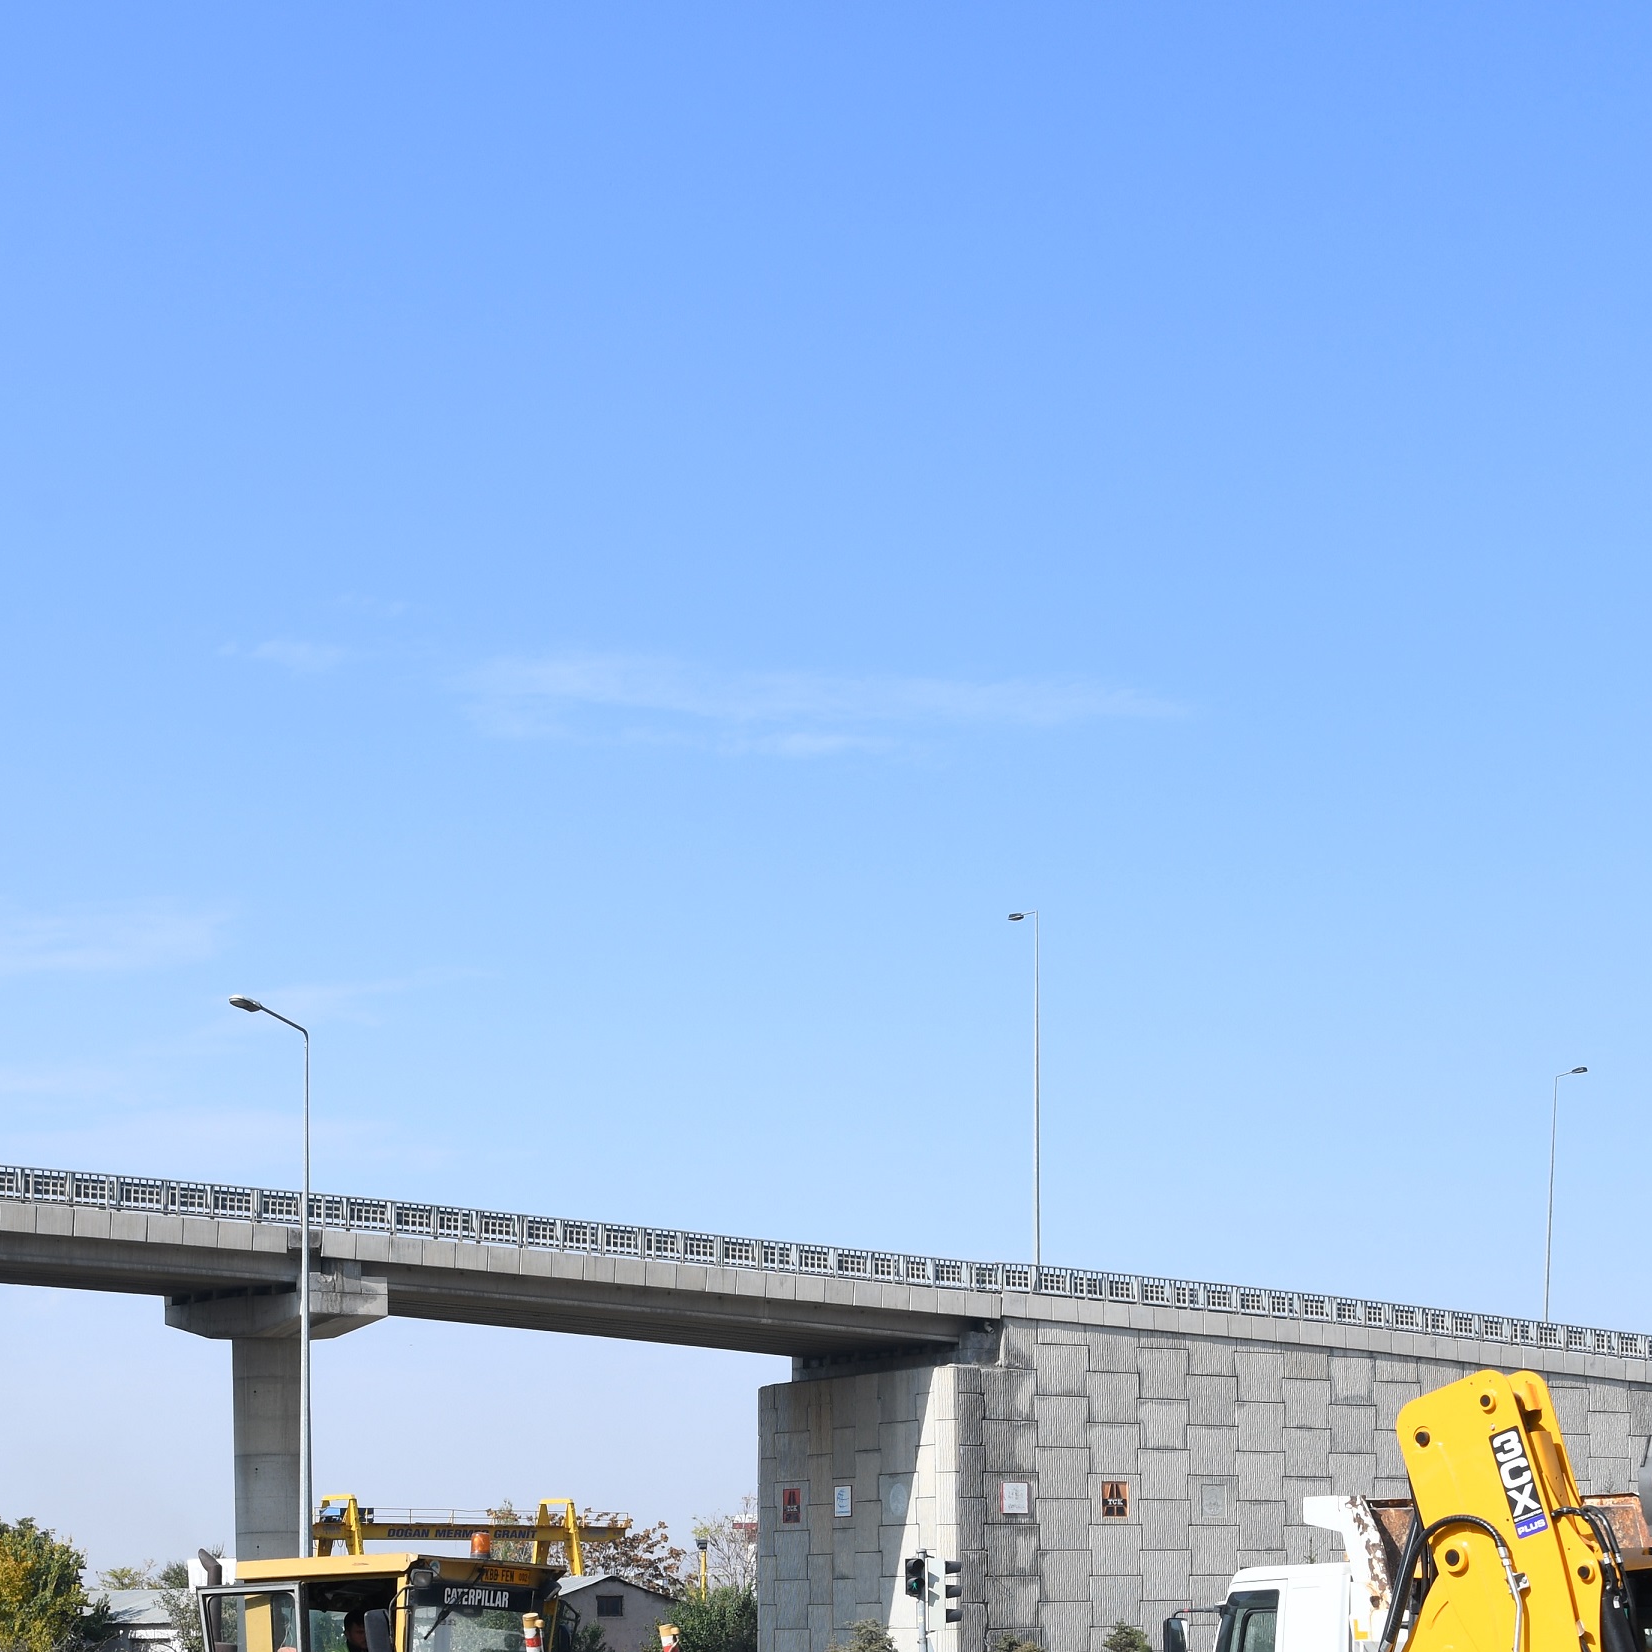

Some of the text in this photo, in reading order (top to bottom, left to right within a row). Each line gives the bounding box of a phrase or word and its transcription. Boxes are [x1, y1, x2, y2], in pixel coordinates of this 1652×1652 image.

[1492, 1430, 1540, 1518] 3CX
[387, 1526, 431, 1538] DOĞAN
[494, 1528, 537, 1539] GRANİT
[1517, 1519, 1546, 1535] PLUS
[444, 1587, 509, 1608] CATERPILLAR
